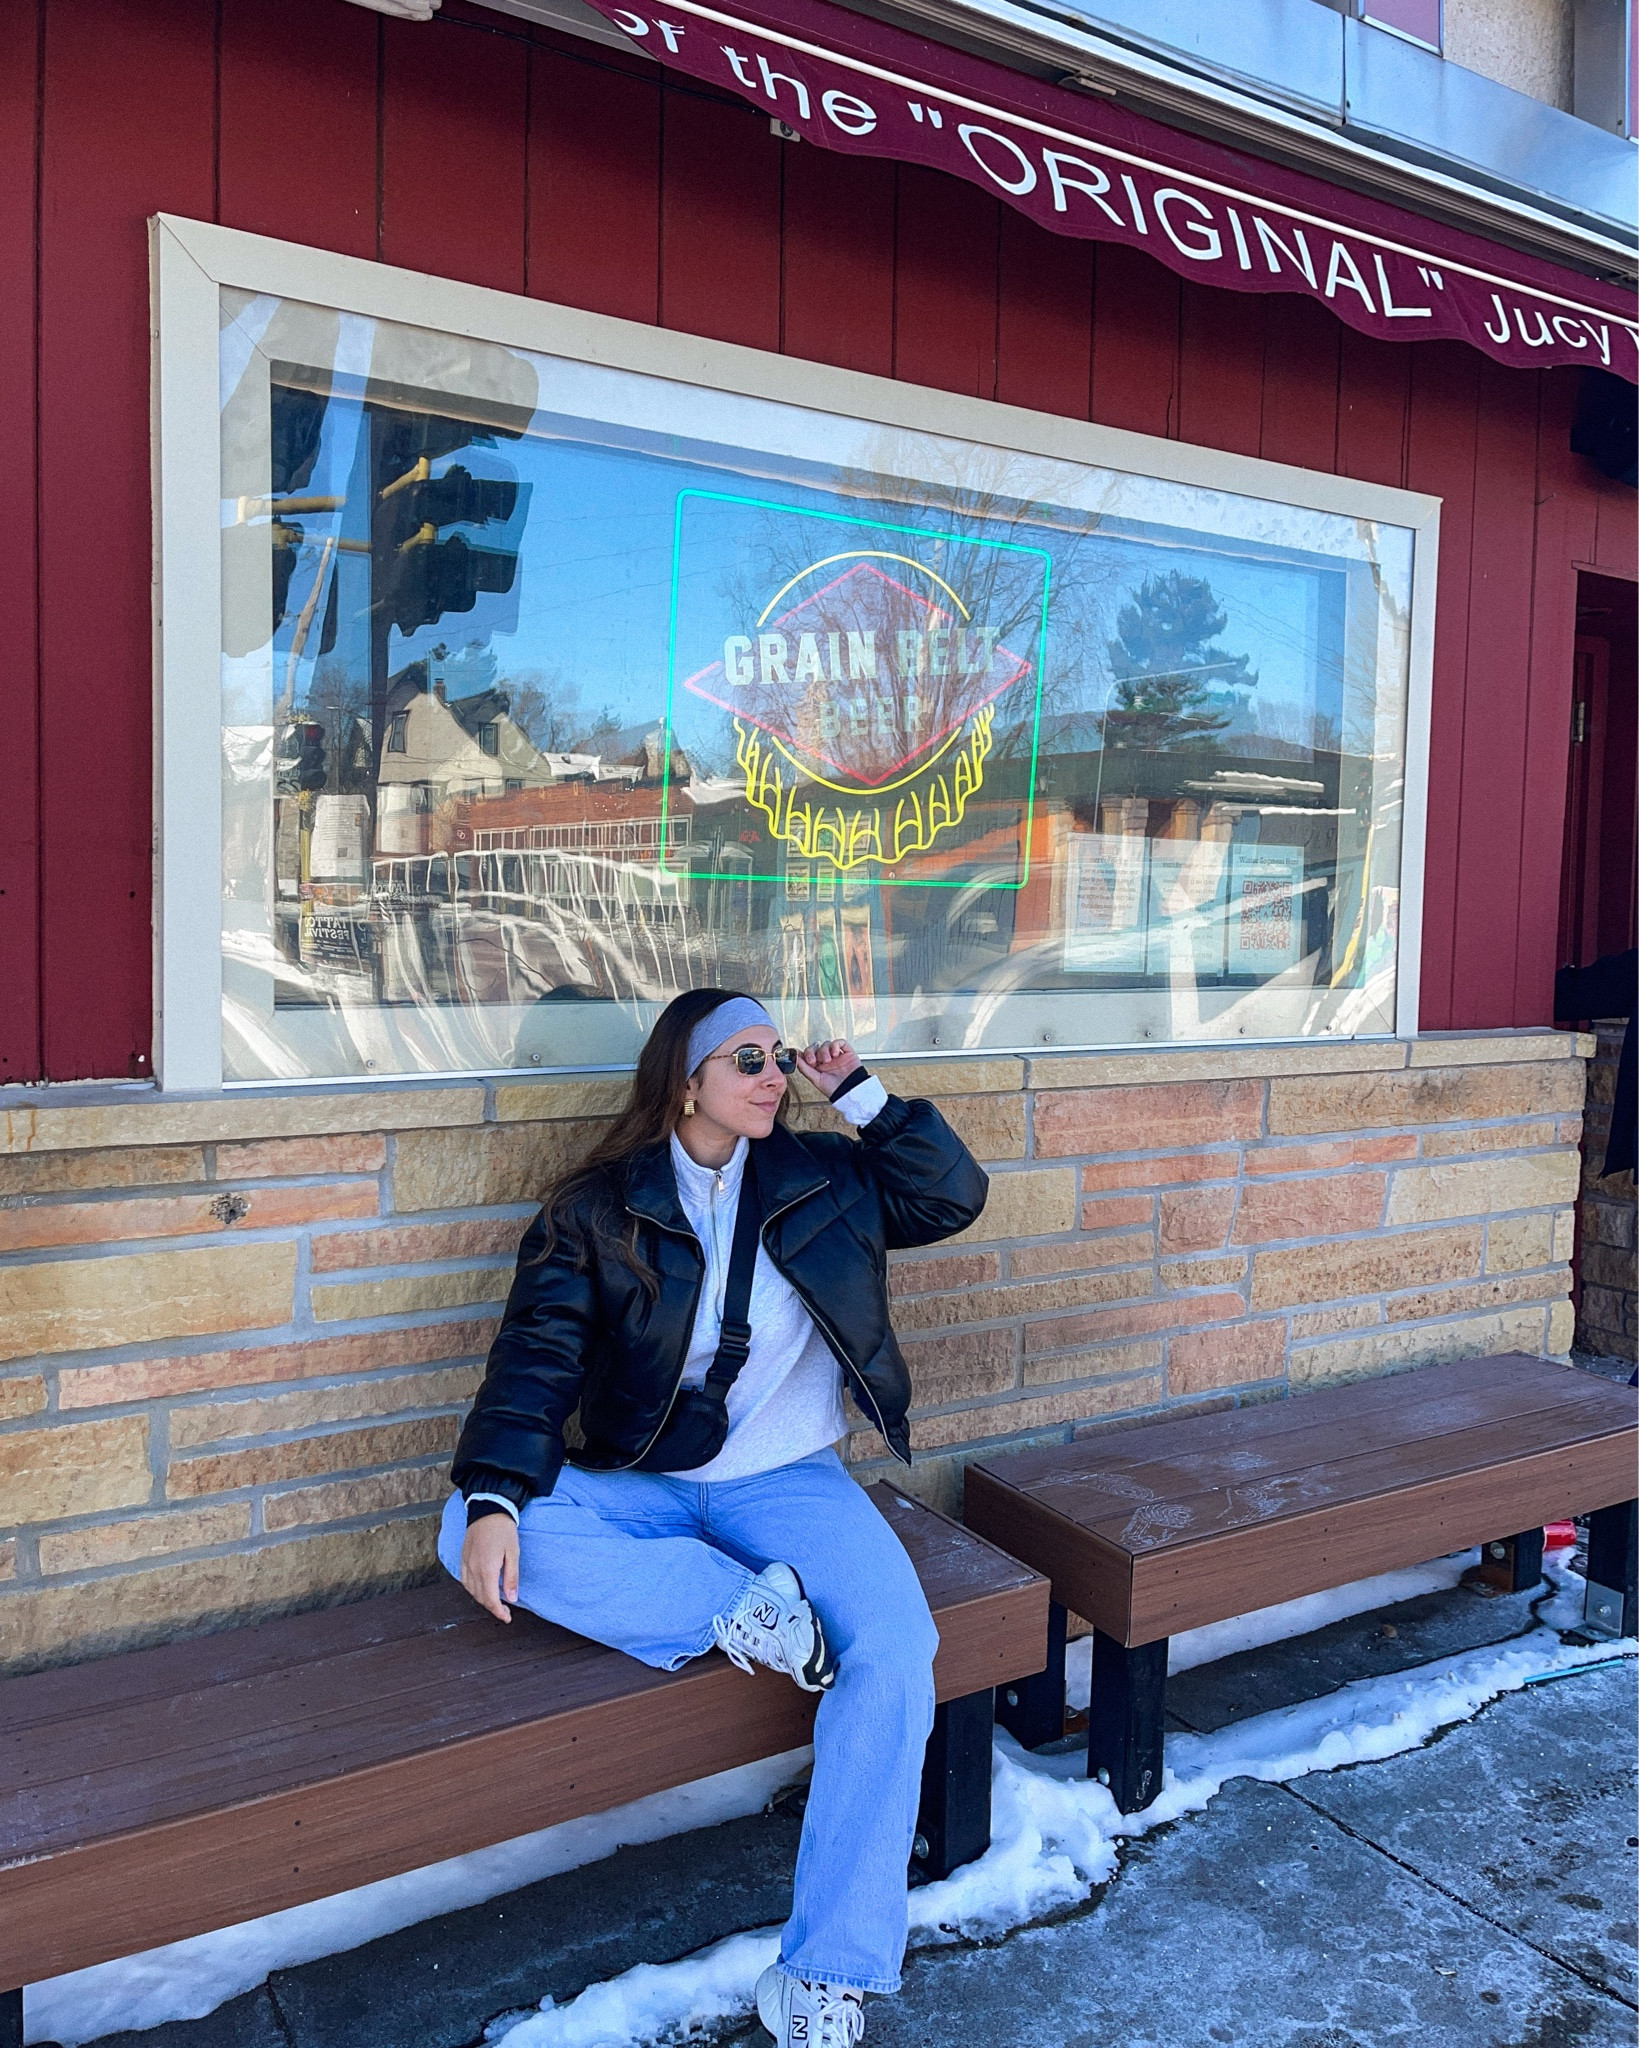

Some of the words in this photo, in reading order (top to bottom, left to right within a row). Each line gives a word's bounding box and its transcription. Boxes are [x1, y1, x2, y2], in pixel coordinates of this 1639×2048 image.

[719, 45, 878, 136] the
[907, 100, 1445, 318] "ORIGINAL"
[1483, 293, 1611, 366] Jucy
[722, 630, 877, 687] GRAIN
[896, 625, 1001, 678] BELT
[819, 695, 926, 739] BEER
[753, 1601, 775, 1623] N
